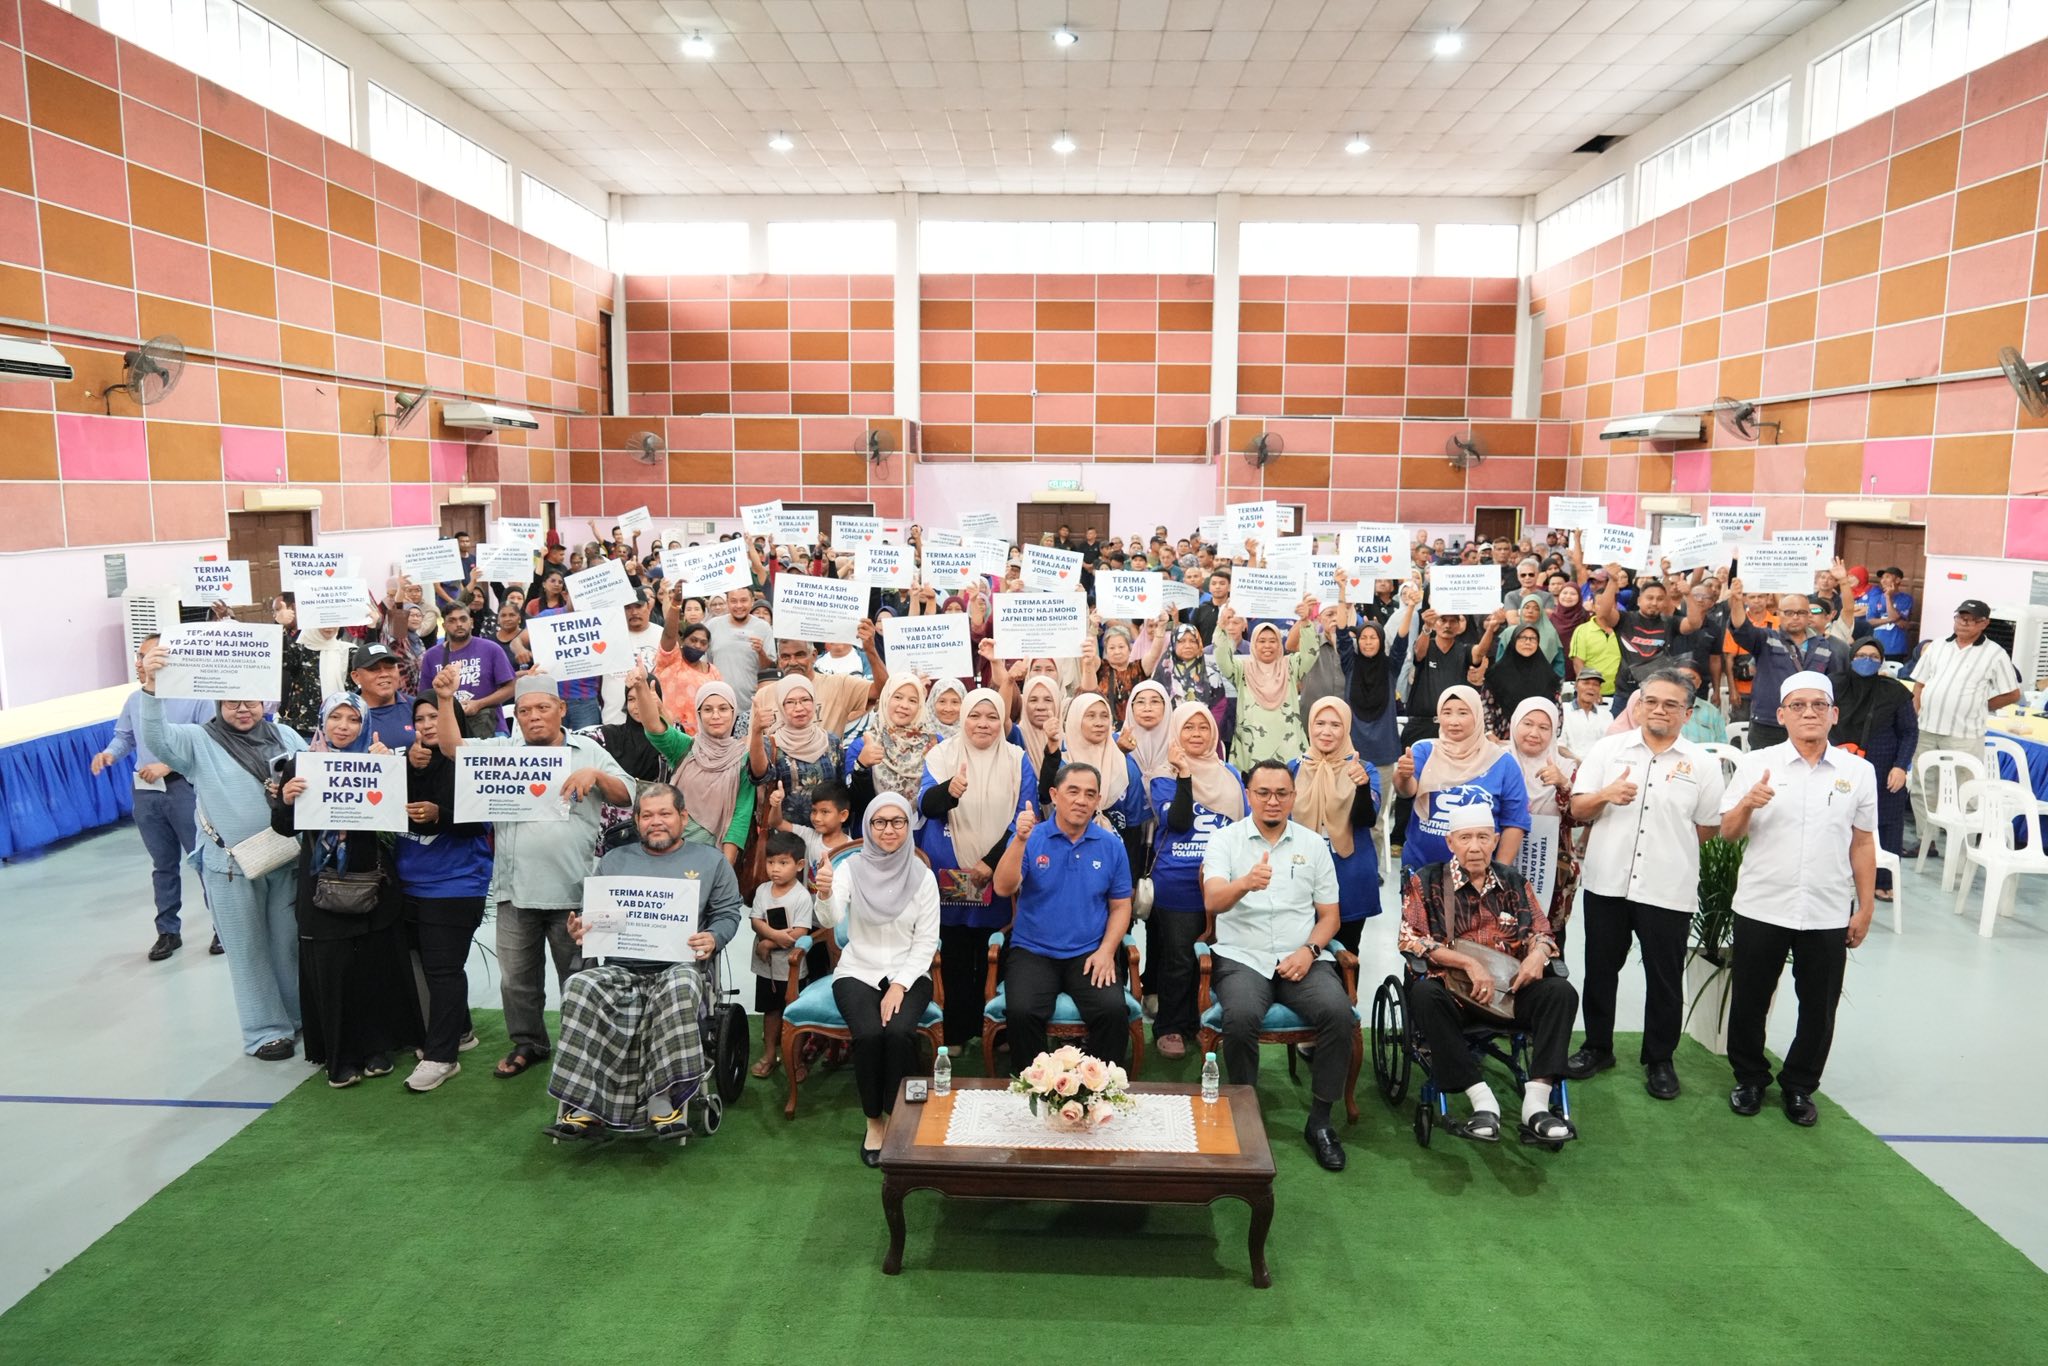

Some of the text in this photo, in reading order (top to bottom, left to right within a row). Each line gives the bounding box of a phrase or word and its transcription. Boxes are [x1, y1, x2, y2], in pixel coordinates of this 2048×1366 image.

[1603, 528, 1634, 538] TERIMA
[1604, 536, 1630, 545] KASIH
[1028, 550, 1078, 564] TERIMA KASIH
[1032, 559, 1071, 571] KERAJAAN
[1032, 566, 1057, 576] JOHOR
[829, 602, 859, 610] SHUKOR
[551, 617, 602, 633] TERIMA
[558, 631, 600, 646] KASIH
[555, 646, 590, 660] PKPJ
[470, 658, 480, 666] OF
[324, 761, 382, 773] TERIMA
[463, 757, 562, 767] TERIMA KASIH
[474, 771, 551, 781] KERAJAAN
[329, 777, 378, 788] KASIH
[476, 784, 525, 794] JOHOR
[322, 792, 363, 803] PKPJ
[609, 889, 674, 899] TERIMA KASIH
[638, 901, 666, 909] DATO'
[626, 910, 642, 919] FIZ
[660, 913, 689, 922] GHAZI
